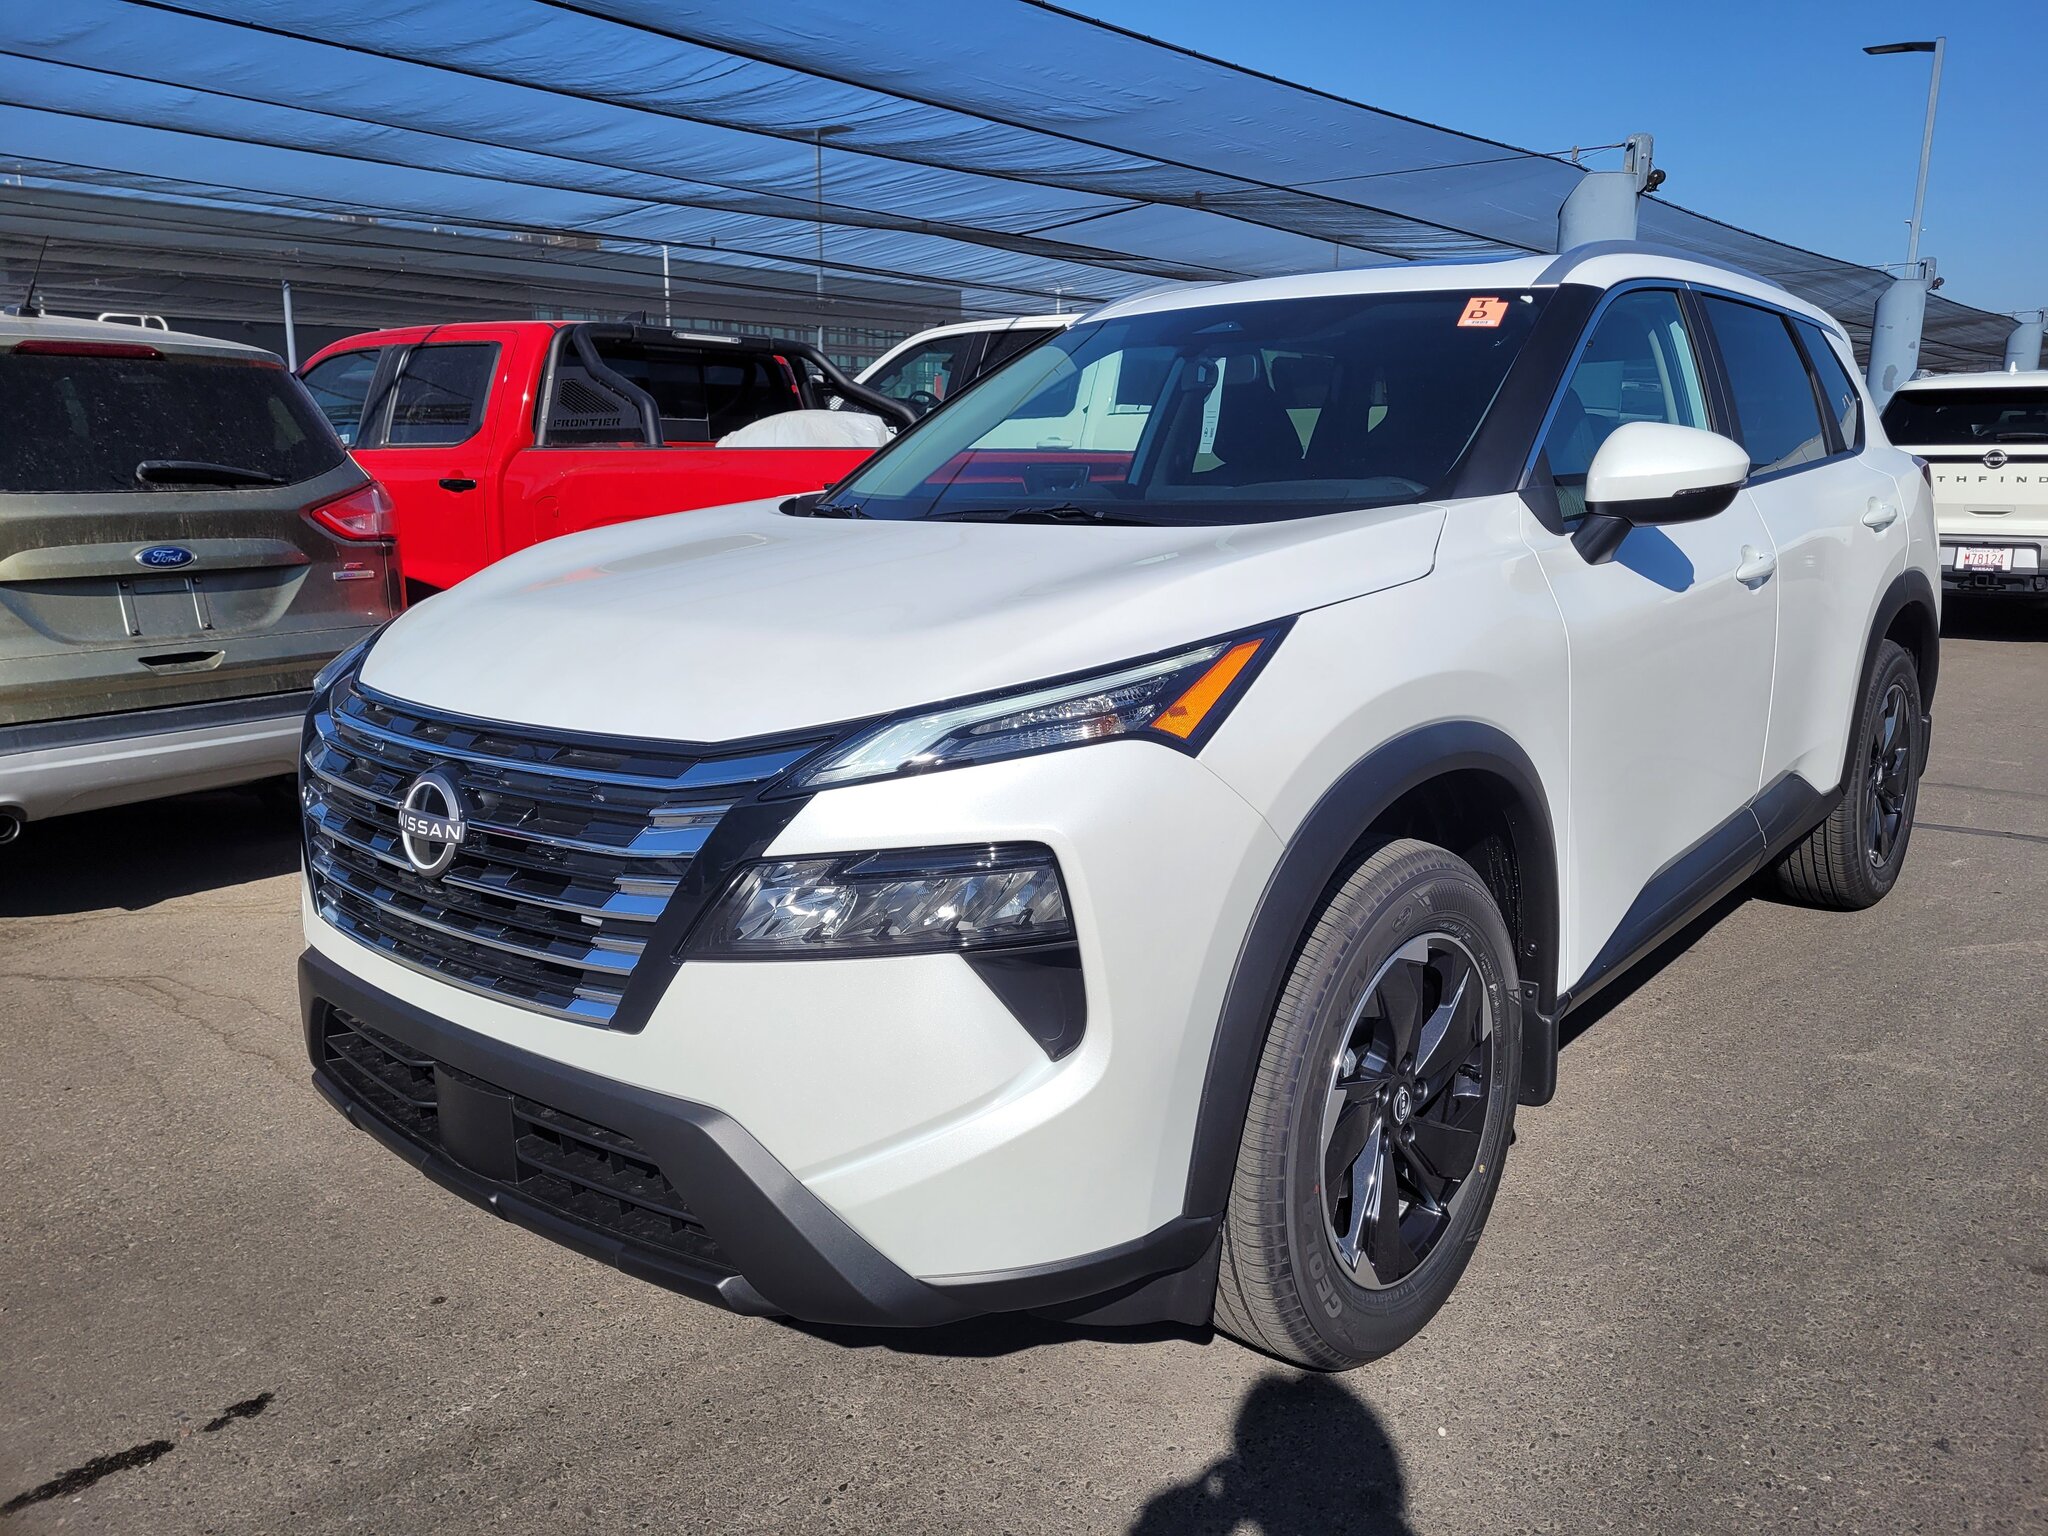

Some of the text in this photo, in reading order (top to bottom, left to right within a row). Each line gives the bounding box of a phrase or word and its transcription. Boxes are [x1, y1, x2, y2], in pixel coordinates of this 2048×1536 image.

[1477, 300, 1492, 308] T
[1468, 310, 1487, 318] D
[553, 417, 621, 427] FRONTIER
[151, 549, 182, 564] Ford
[398, 809, 461, 841] NISSAN
